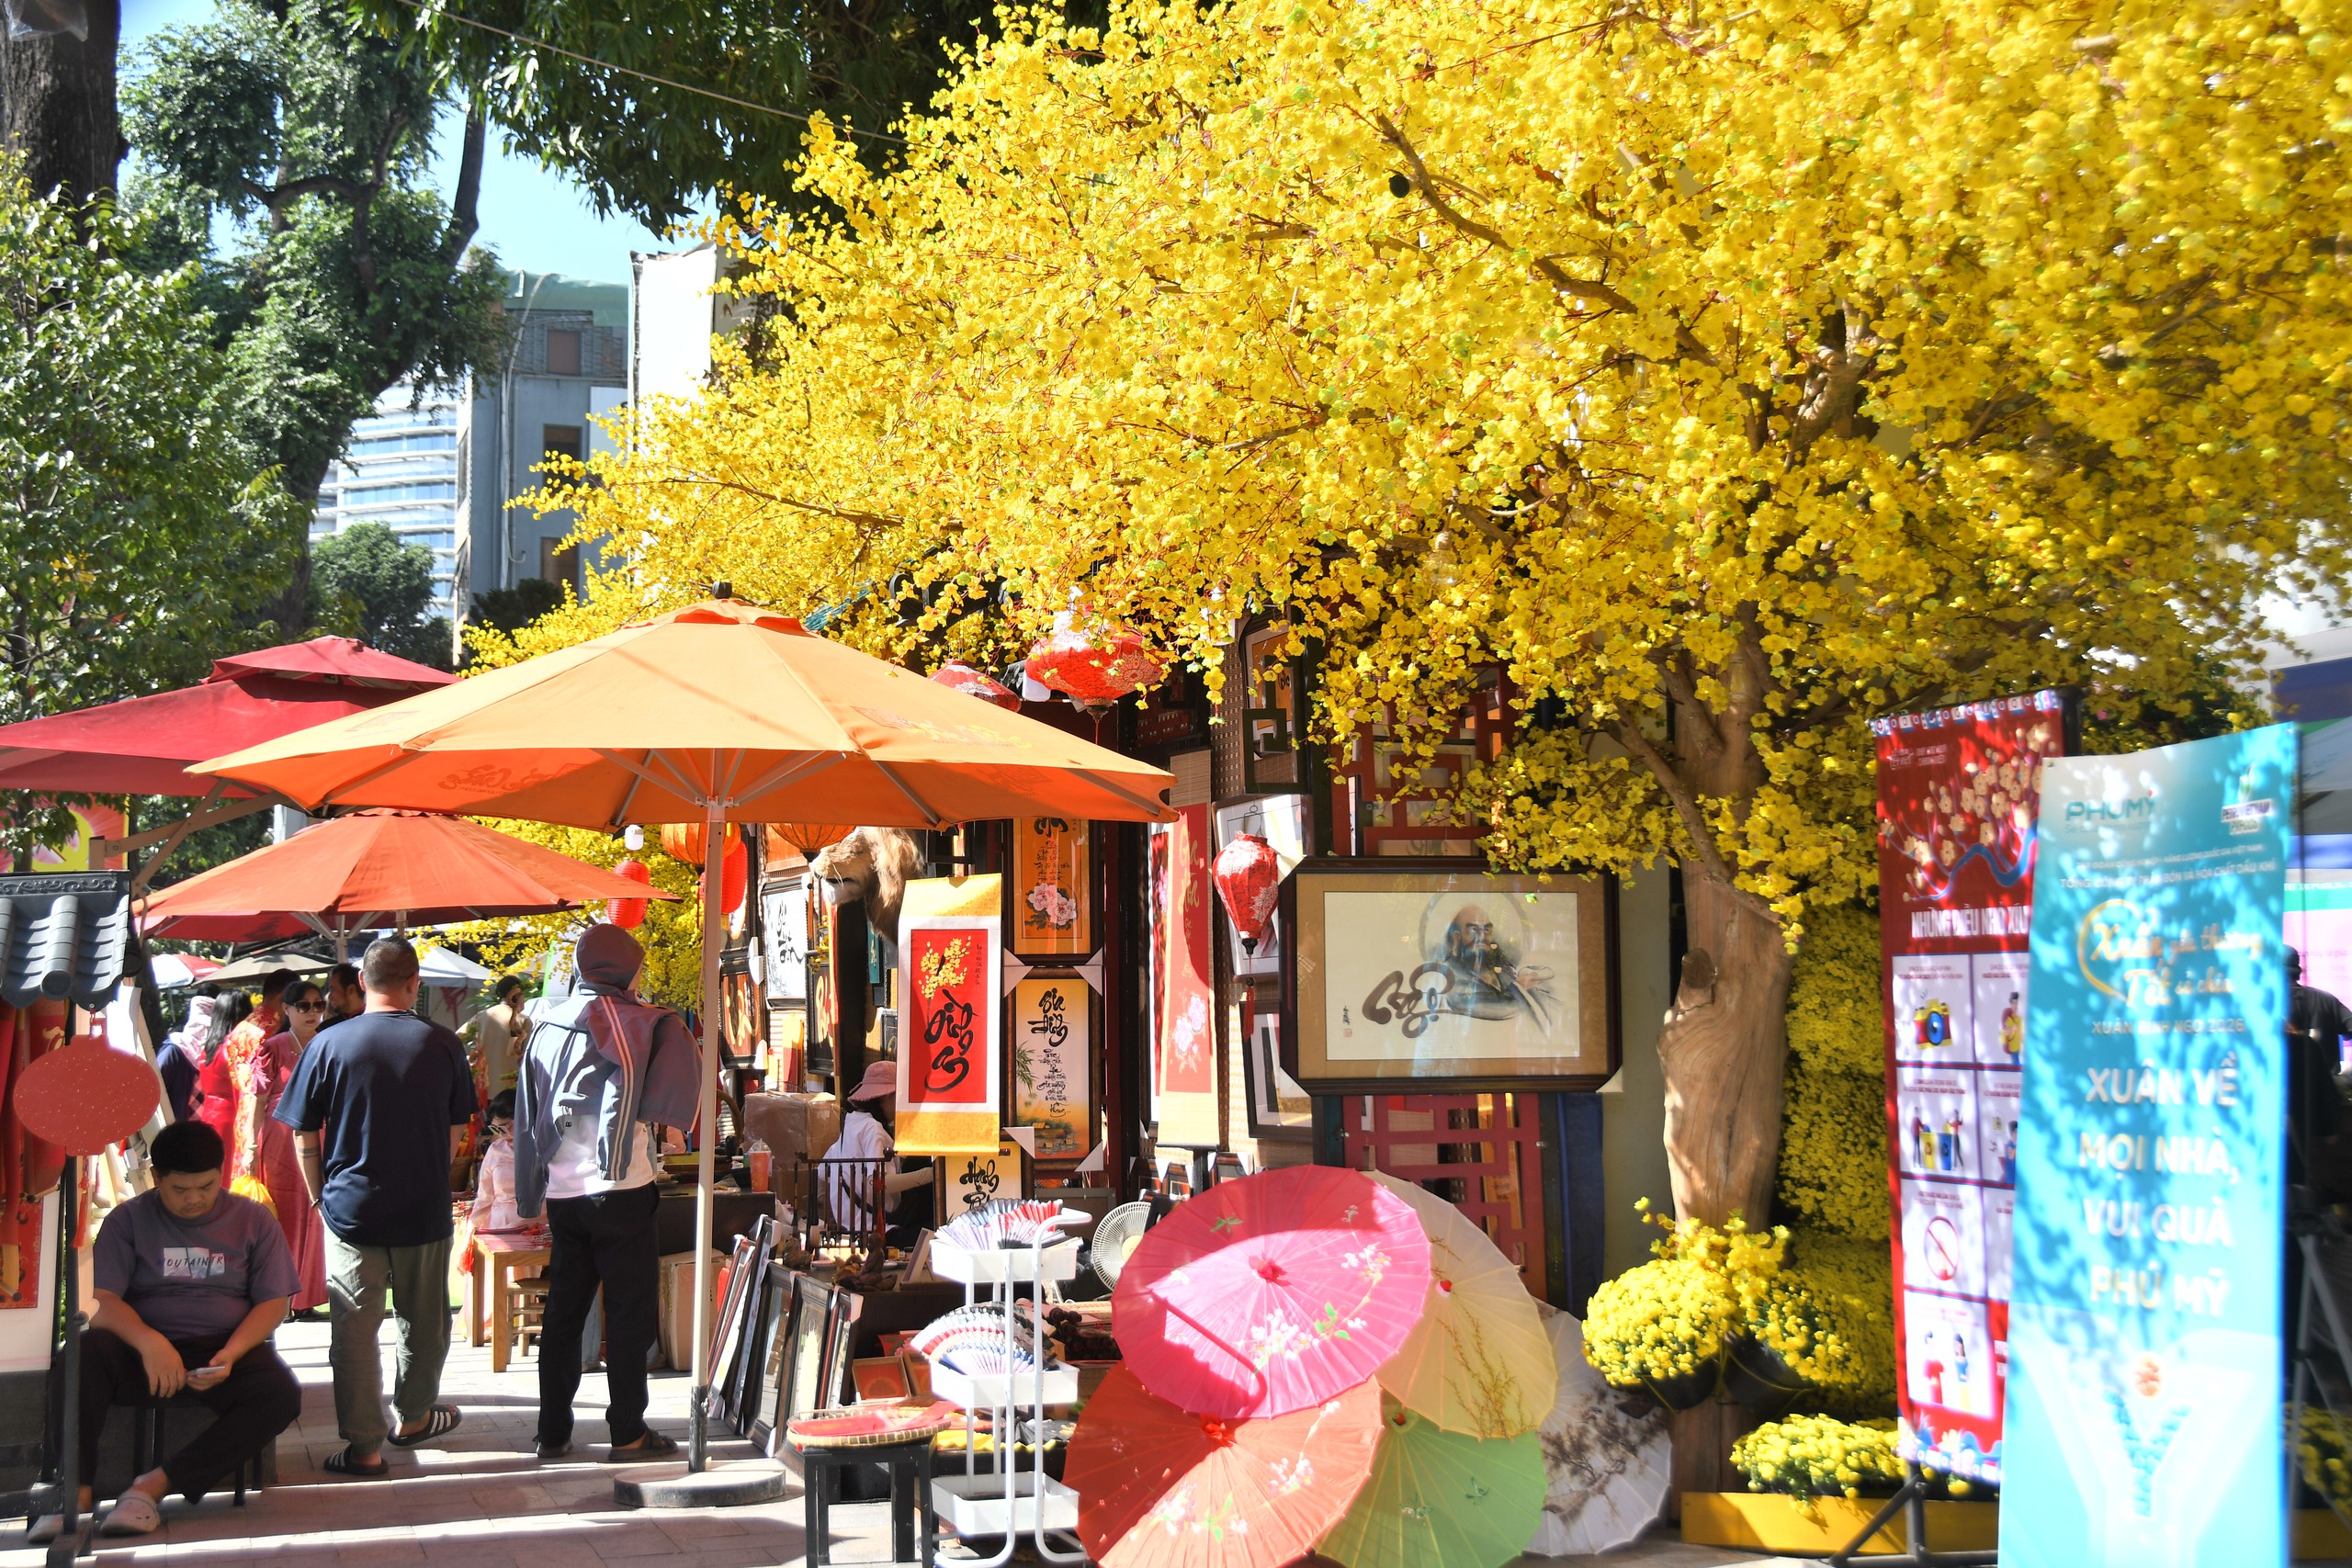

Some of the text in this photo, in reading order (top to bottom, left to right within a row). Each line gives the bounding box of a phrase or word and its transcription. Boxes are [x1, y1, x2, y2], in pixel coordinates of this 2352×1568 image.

[2091, 1017, 2132, 1034] XUÂN
[2207, 1019, 2246, 1033] 2026
[2085, 1050, 2239, 1106] XUÂN VỀ
[2078, 1126, 2241, 1184] MỌI NHÀ,
[2083, 1195, 2234, 1247] VUI QUÀ
[2090, 1259, 2233, 1317] PHÚ MỸ
